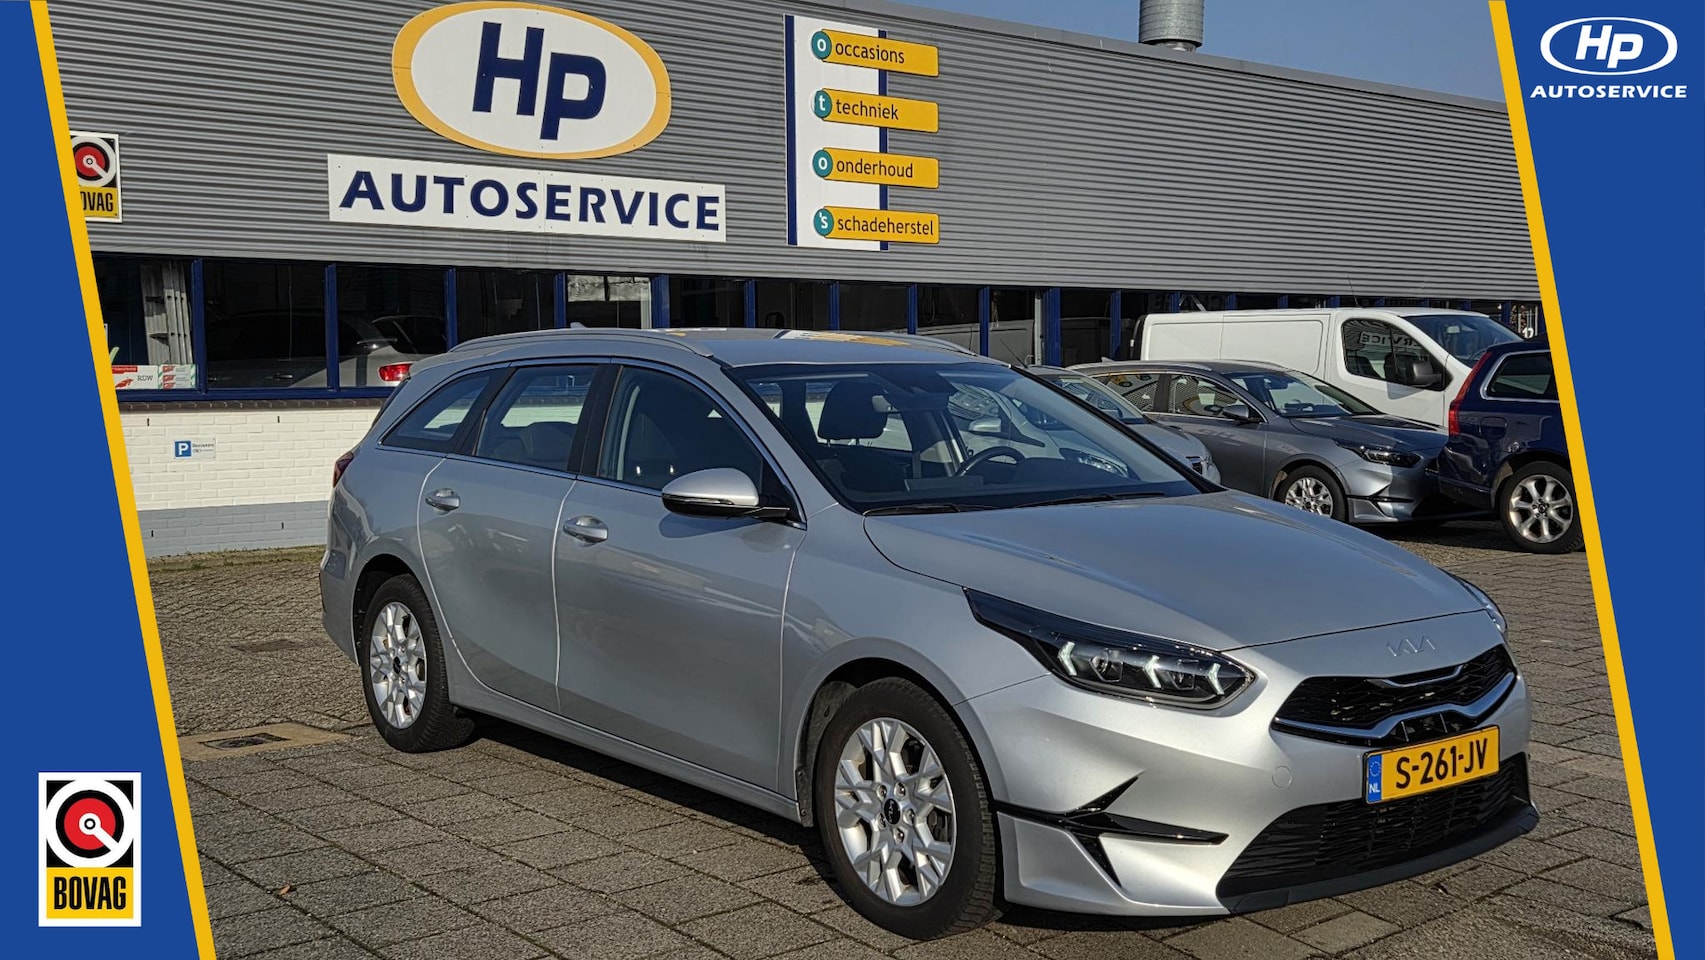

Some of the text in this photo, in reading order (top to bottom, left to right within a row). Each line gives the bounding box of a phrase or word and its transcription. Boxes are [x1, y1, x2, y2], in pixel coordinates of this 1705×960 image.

[835, 42, 905, 64] occasions
[836, 99, 899, 121] techniek
[836, 158, 913, 178] onderhoud
[339, 170, 720, 231] AUTOSERVICE
[837, 215, 934, 236] schadeherstel
[178, 443, 189, 456] P
[1369, 738, 1488, 793] NL S-261-JV
